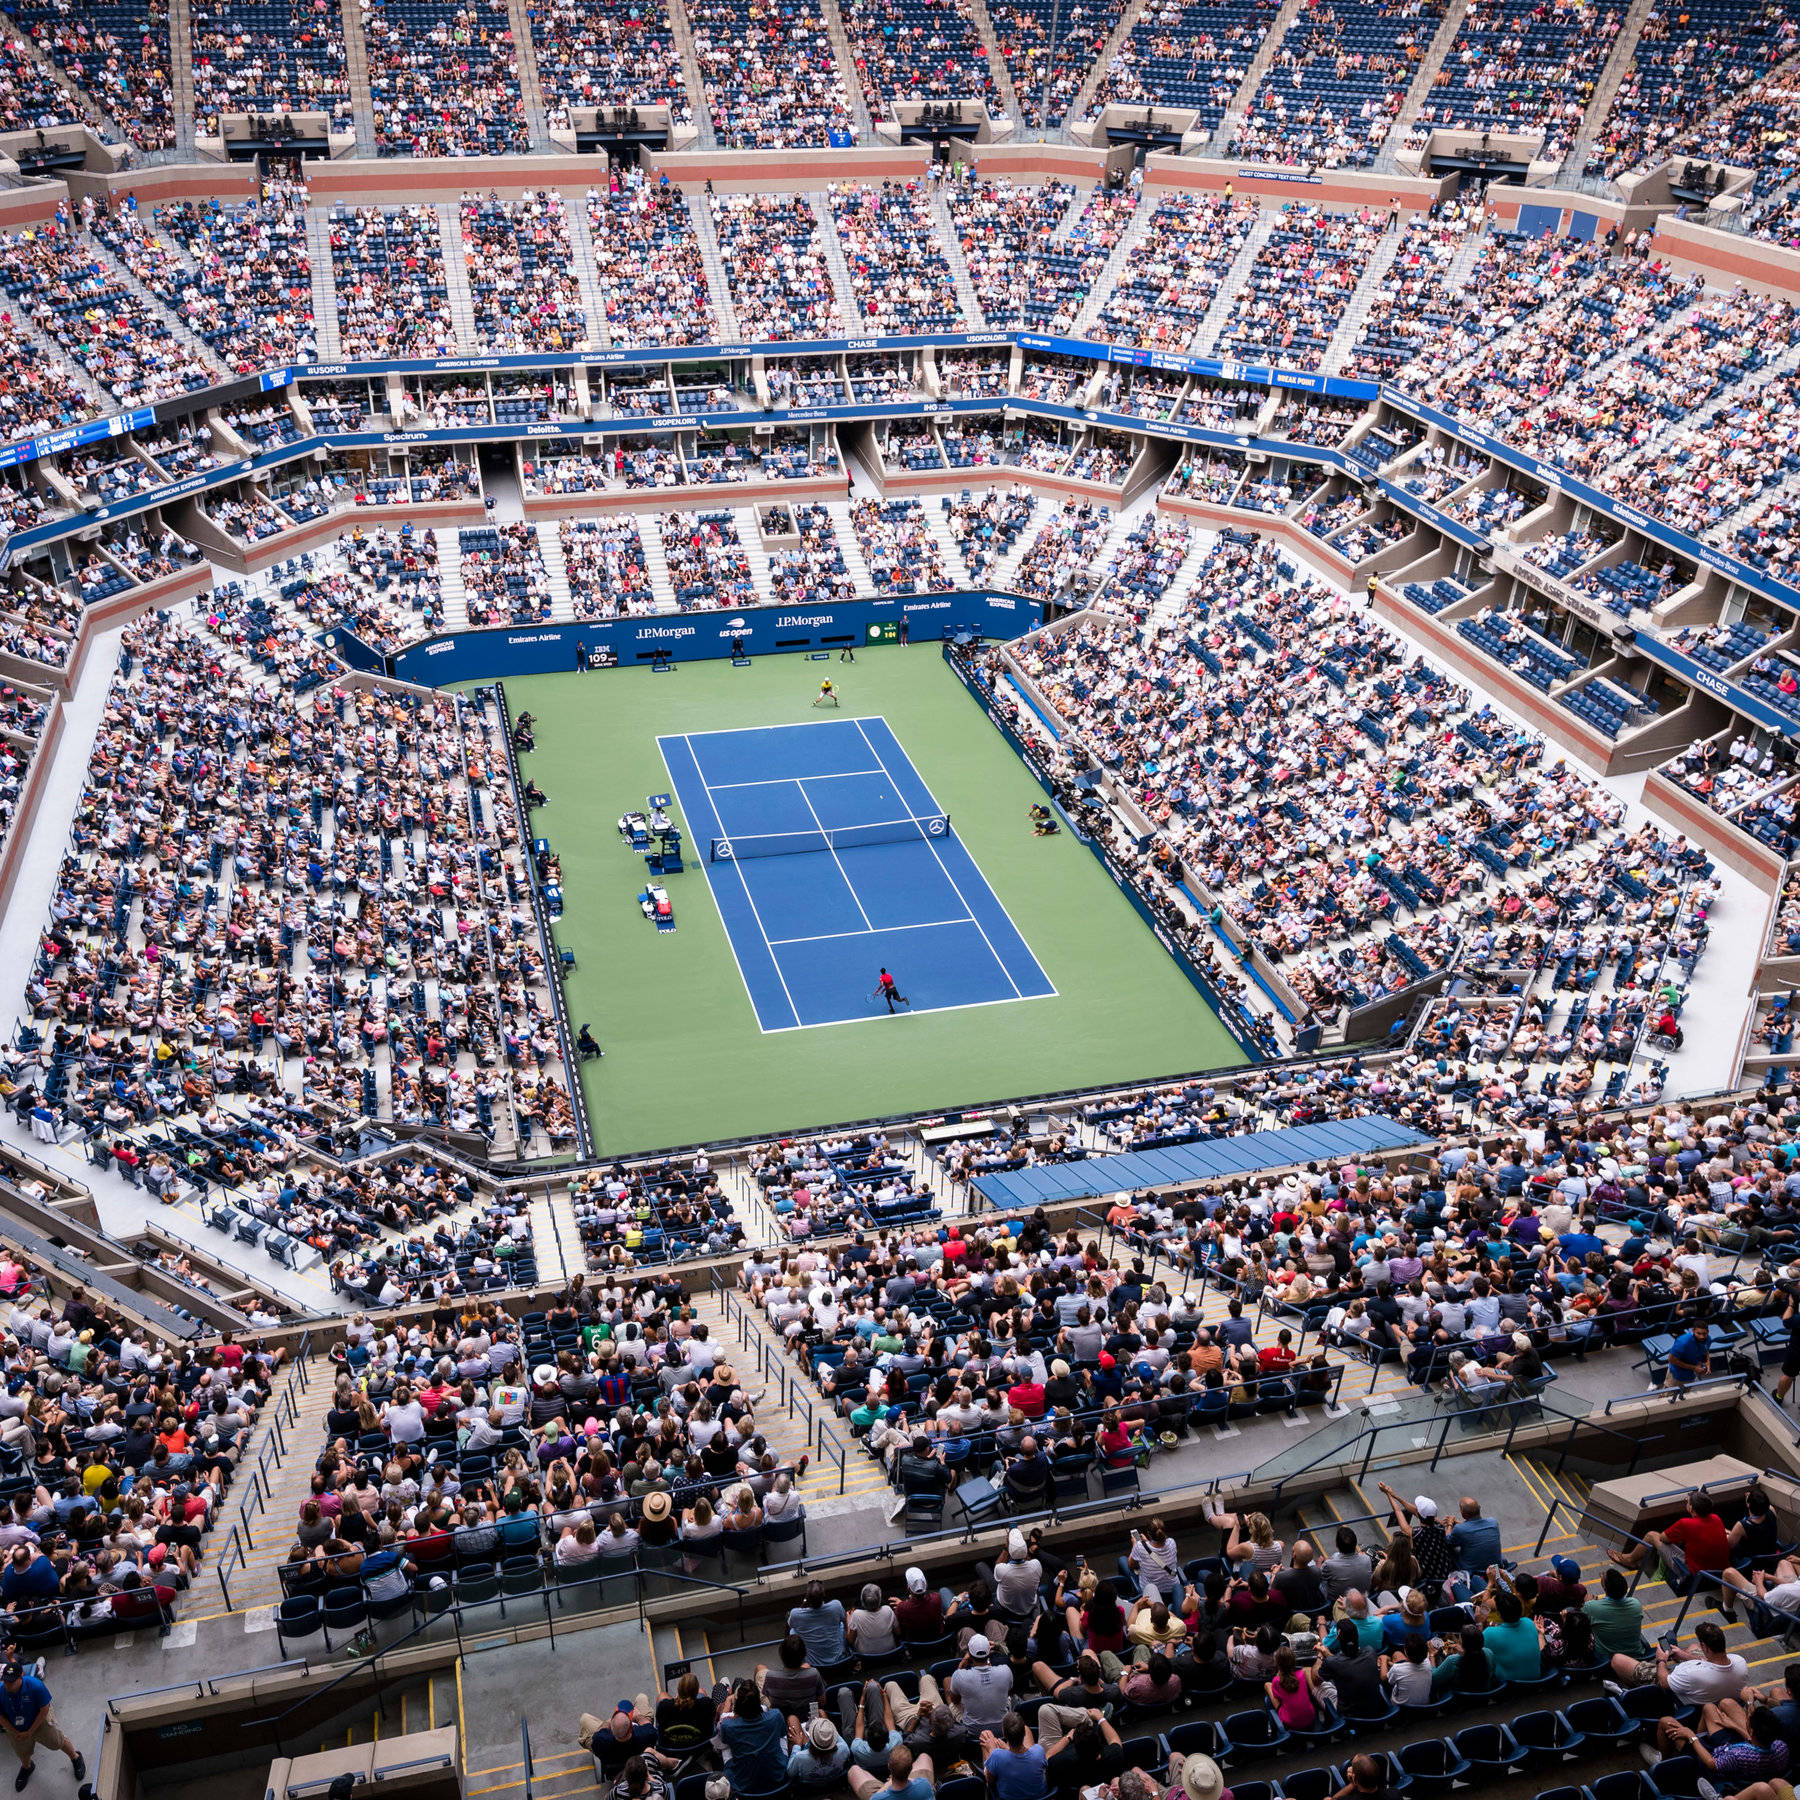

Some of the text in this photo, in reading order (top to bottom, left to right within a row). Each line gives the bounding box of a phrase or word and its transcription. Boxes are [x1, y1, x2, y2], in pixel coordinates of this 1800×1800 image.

[966, 334, 1007, 342] USOPEN.ORG
[847, 340, 878, 349] CHASE
[307, 365, 347, 374] #USOPEN
[435, 360, 469, 368] AMERICAN
[1277, 374, 1316, 387] BREAK POINT
[652, 417, 697, 427] USOPEN.ORG
[383, 432, 425, 443] Spectrum
[1344, 459, 1360, 476] WTA
[150, 477, 207, 501] AMERICAN EXPRESS
[1698, 547, 1740, 575] Mercedes-Benz
[903, 601, 952, 612] Emirates Airline
[985, 597, 1016, 605] AMERICAN
[989, 602, 1016, 610] EXPRESS
[775, 615, 834, 628] J.P.Morgan
[635, 626, 696, 640] J.P.Morgan
[719, 628, 753, 639] us open
[508, 634, 561, 644] Emirates Airline
[425, 640, 455, 653] AMERICAN
[428, 645, 455, 656] EXPRESS
[594, 645, 611, 653] IBM
[588, 653, 608, 663] 109
[1695, 669, 1730, 698] CHASE
[591, 1334, 602, 1350] 6
